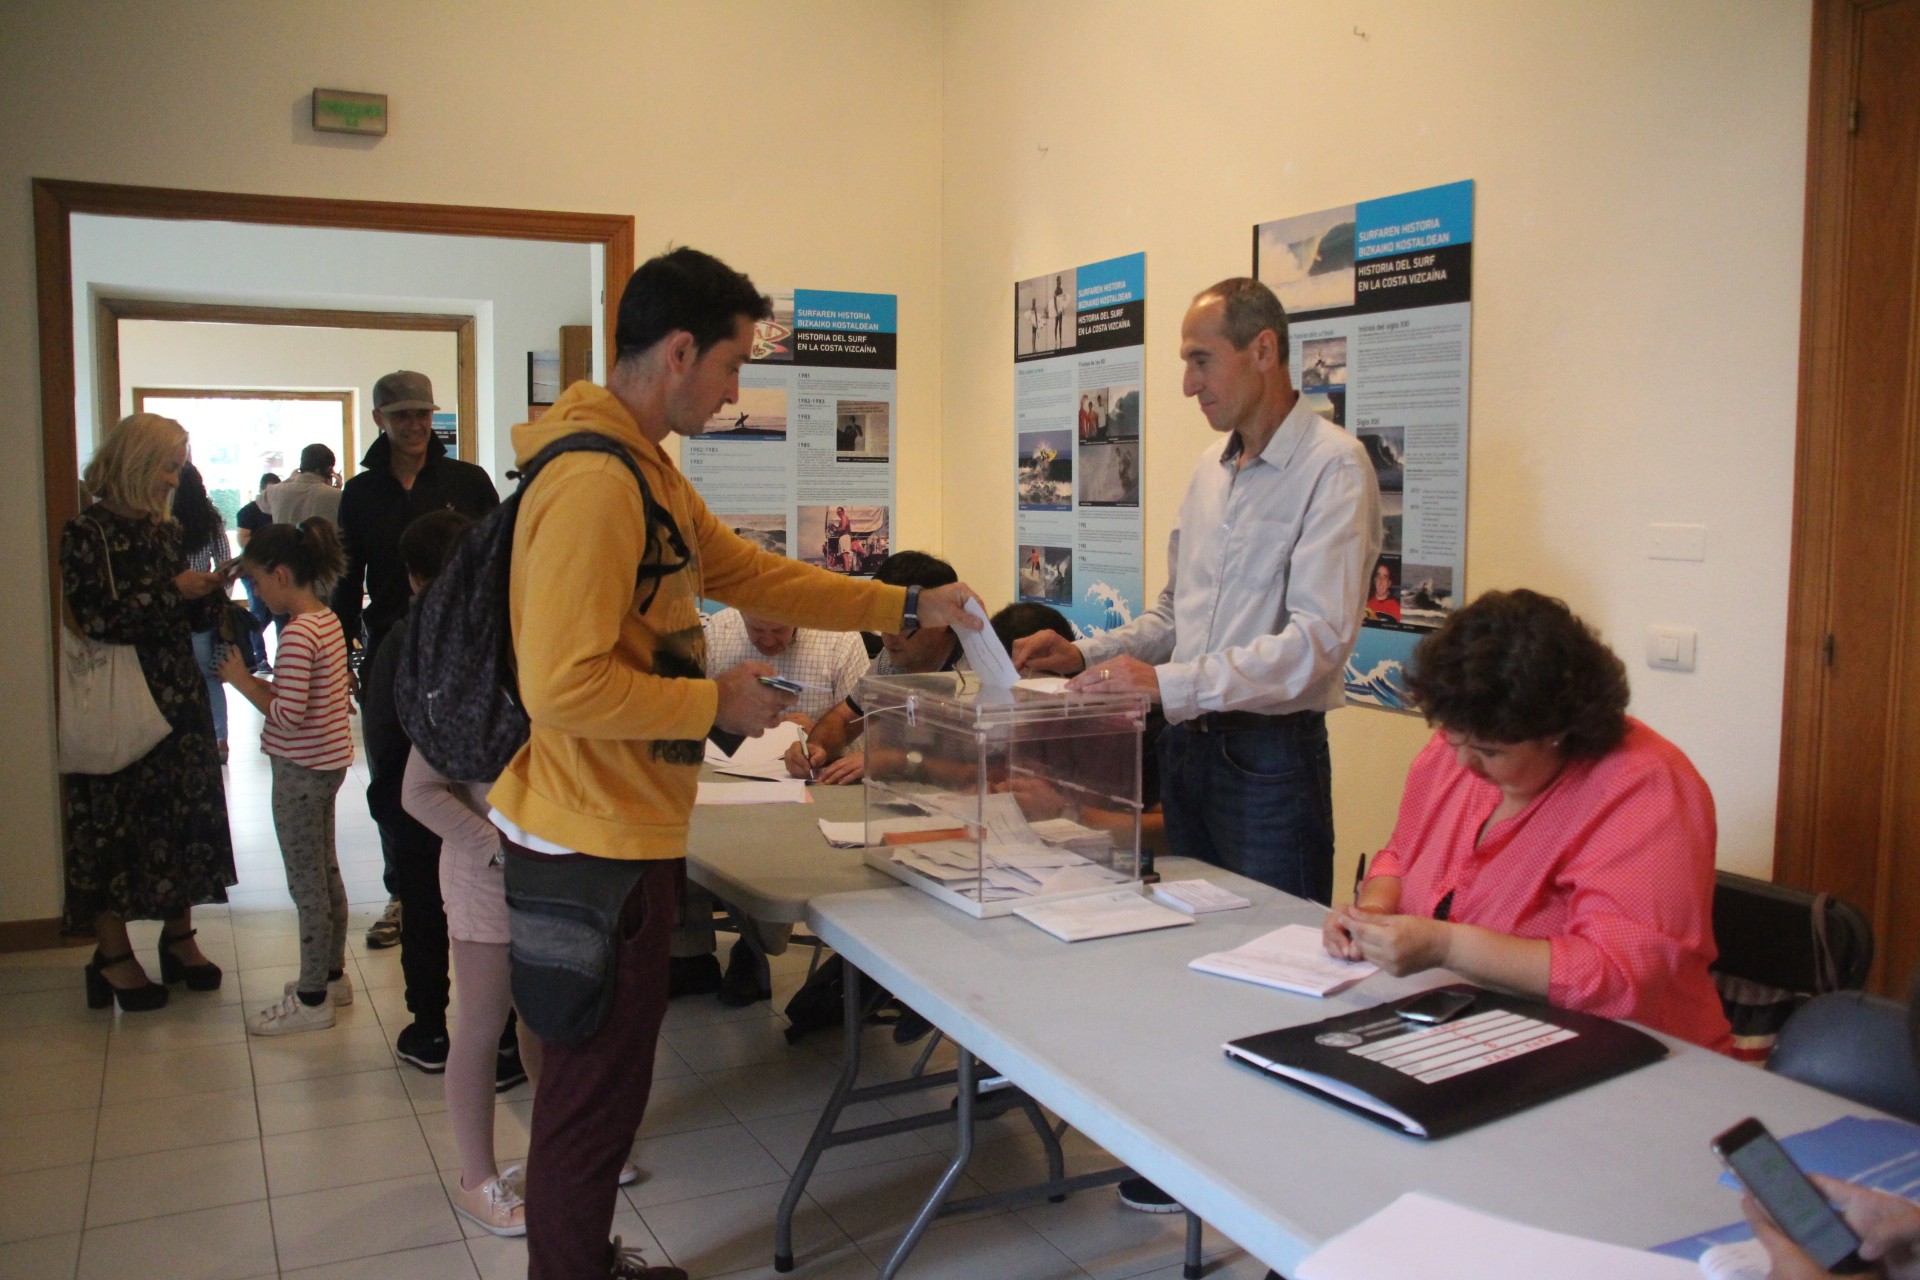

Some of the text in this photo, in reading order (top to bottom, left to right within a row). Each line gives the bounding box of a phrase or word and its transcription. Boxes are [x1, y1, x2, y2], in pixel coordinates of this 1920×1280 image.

[1358, 218, 1440, 242] SURFAREN HISTORIA
[1358, 232, 1450, 257] BIZKAIKO KOSTALDEAN
[1358, 255, 1435, 276] HISTORIA DEL SURF
[1358, 268, 1447, 292] EN LA COSTA VIZCAÍNA
[798, 309, 871, 320] SURFAREN HISTORIA
[1078, 308, 1124, 324] HISTORIA DEL SURF
[798, 320, 878, 330] BIZKAIKO KOSTALDEAN
[1078, 319, 1130, 336] EN LA COSTA VIZCAÍNA
[798, 333, 830, 341] HISTORIA
[848, 335, 867, 343] SURF
[820, 344, 843, 352] COSTA
[844, 345, 877, 353] VIZCAÍNA
